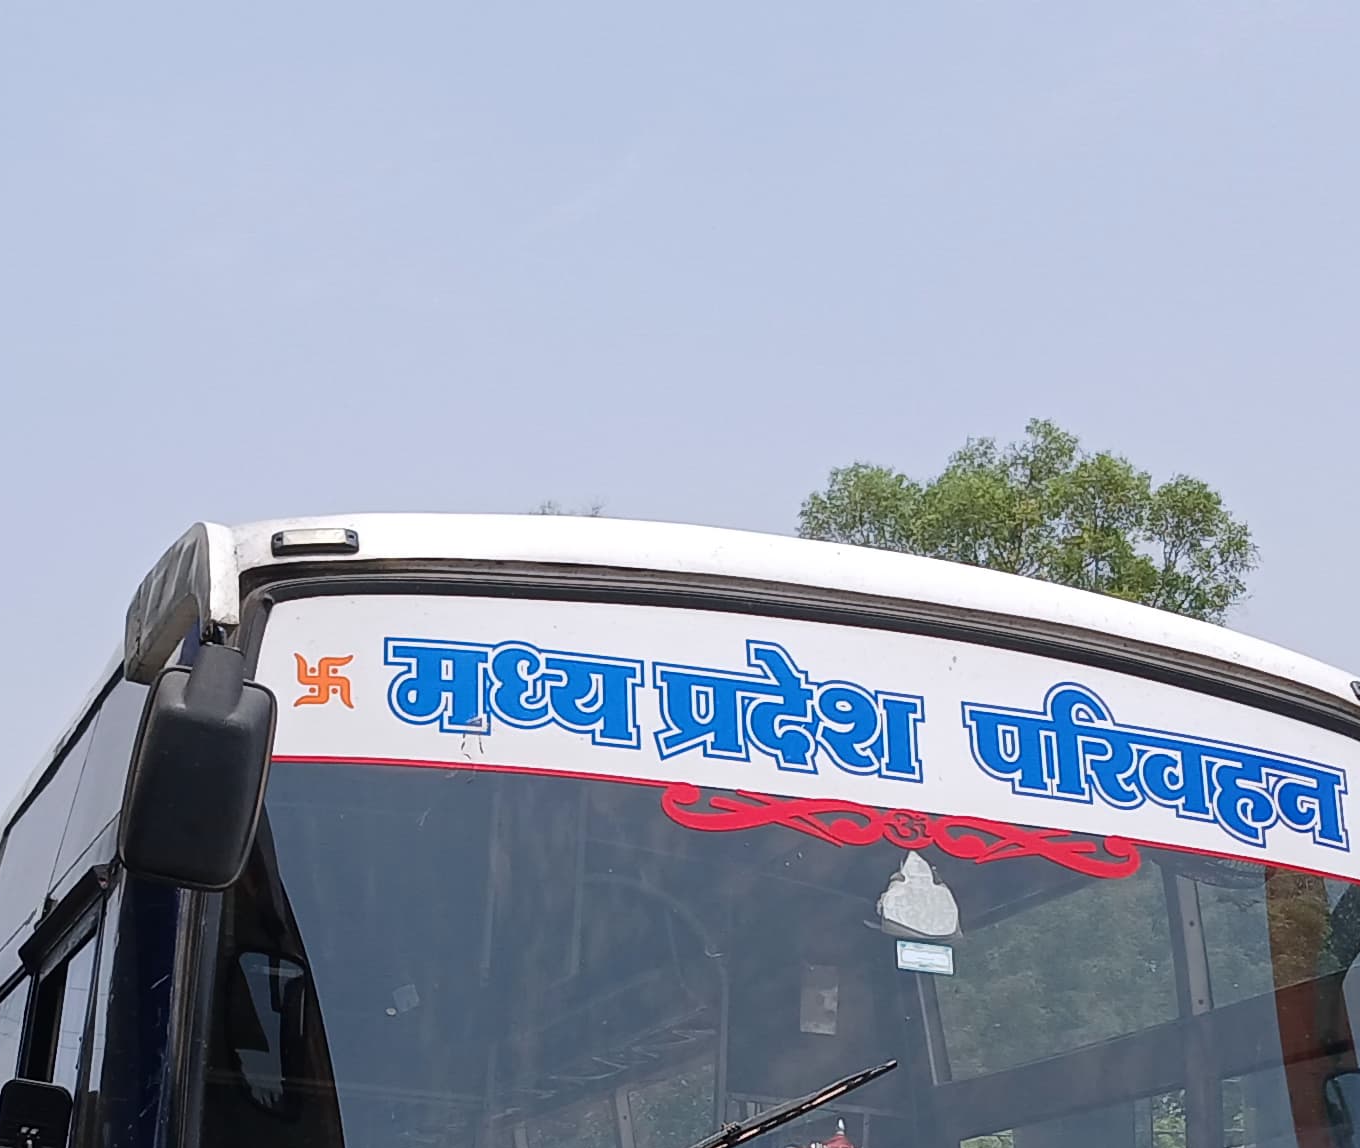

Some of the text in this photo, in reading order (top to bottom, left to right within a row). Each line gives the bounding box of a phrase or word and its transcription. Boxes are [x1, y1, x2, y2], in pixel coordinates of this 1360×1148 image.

[384, 636, 1348, 853] मध्य प्रदेश परिवहन
